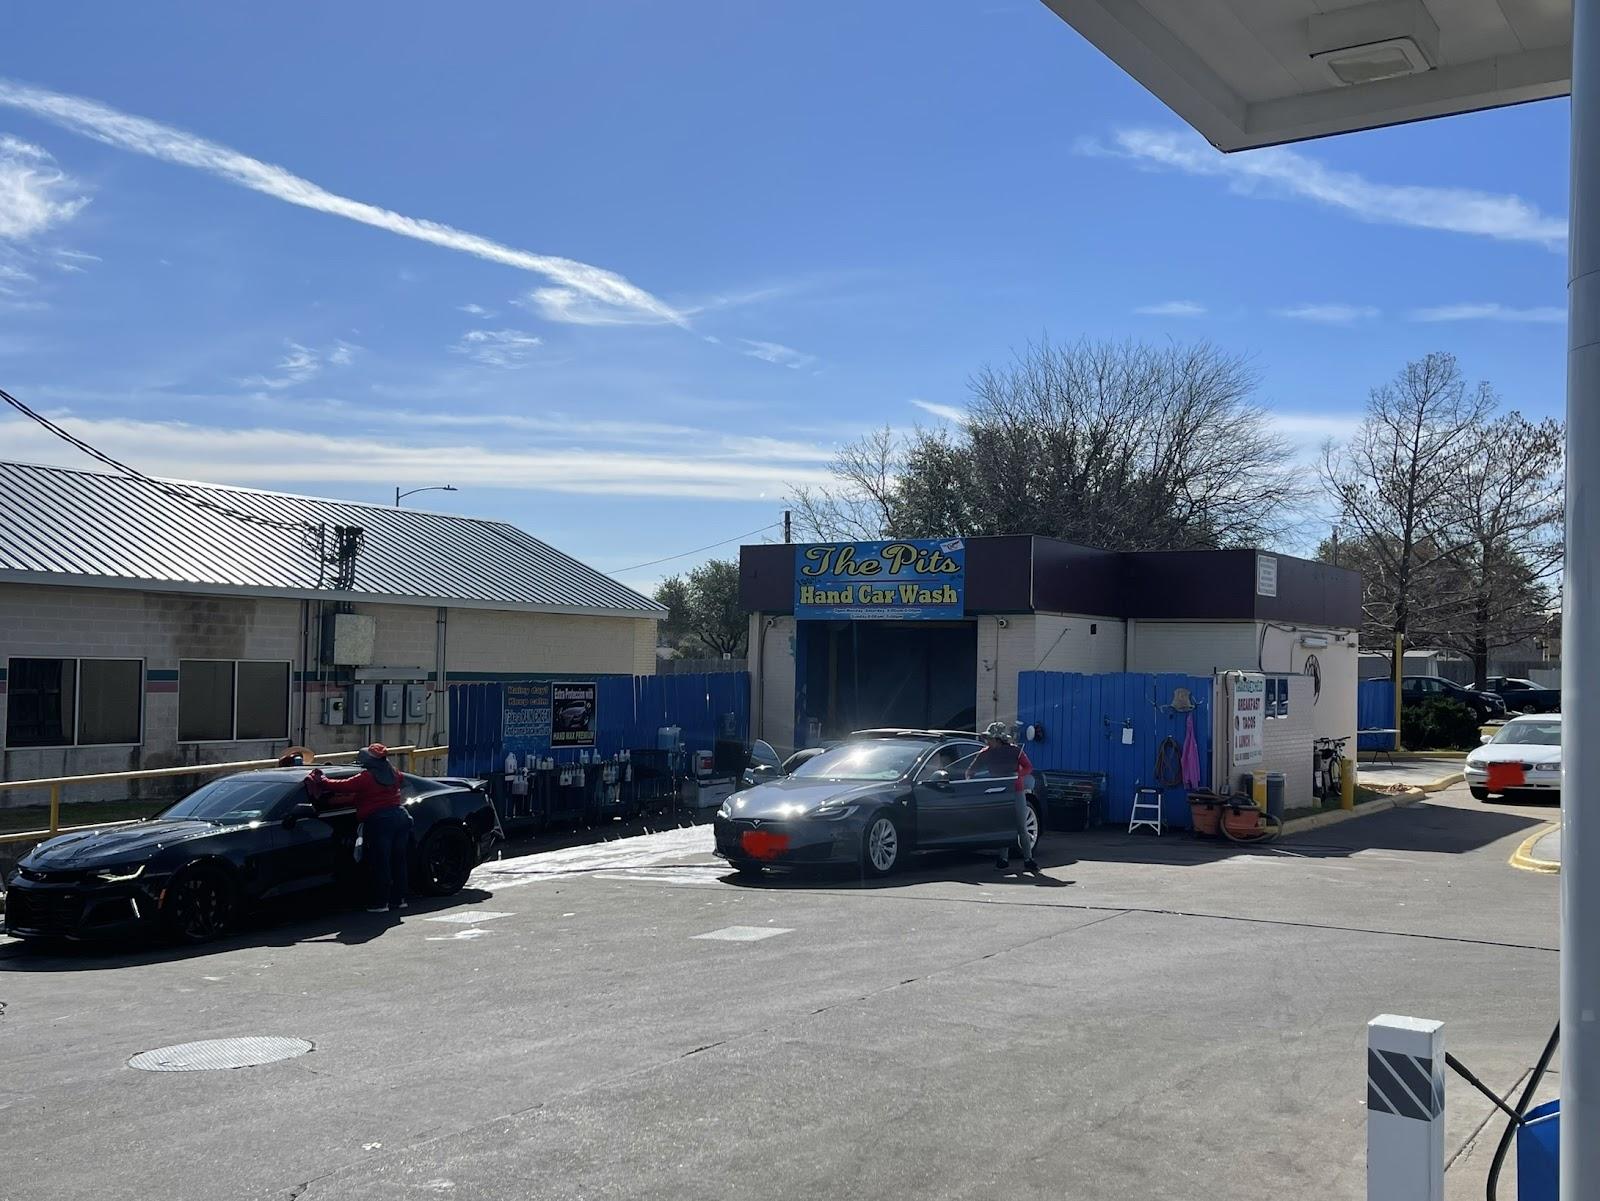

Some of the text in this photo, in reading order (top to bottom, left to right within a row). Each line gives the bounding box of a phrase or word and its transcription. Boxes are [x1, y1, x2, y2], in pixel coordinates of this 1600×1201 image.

[801, 545, 882, 577] The
[880, 543, 962, 575] Pits
[800, 584, 958, 605] Hand Car Wash
[1238, 698, 1260, 711] BREAKFAST
[1242, 716, 1256, 729] TACOS
[1239, 735, 1250, 748] LUNCH
